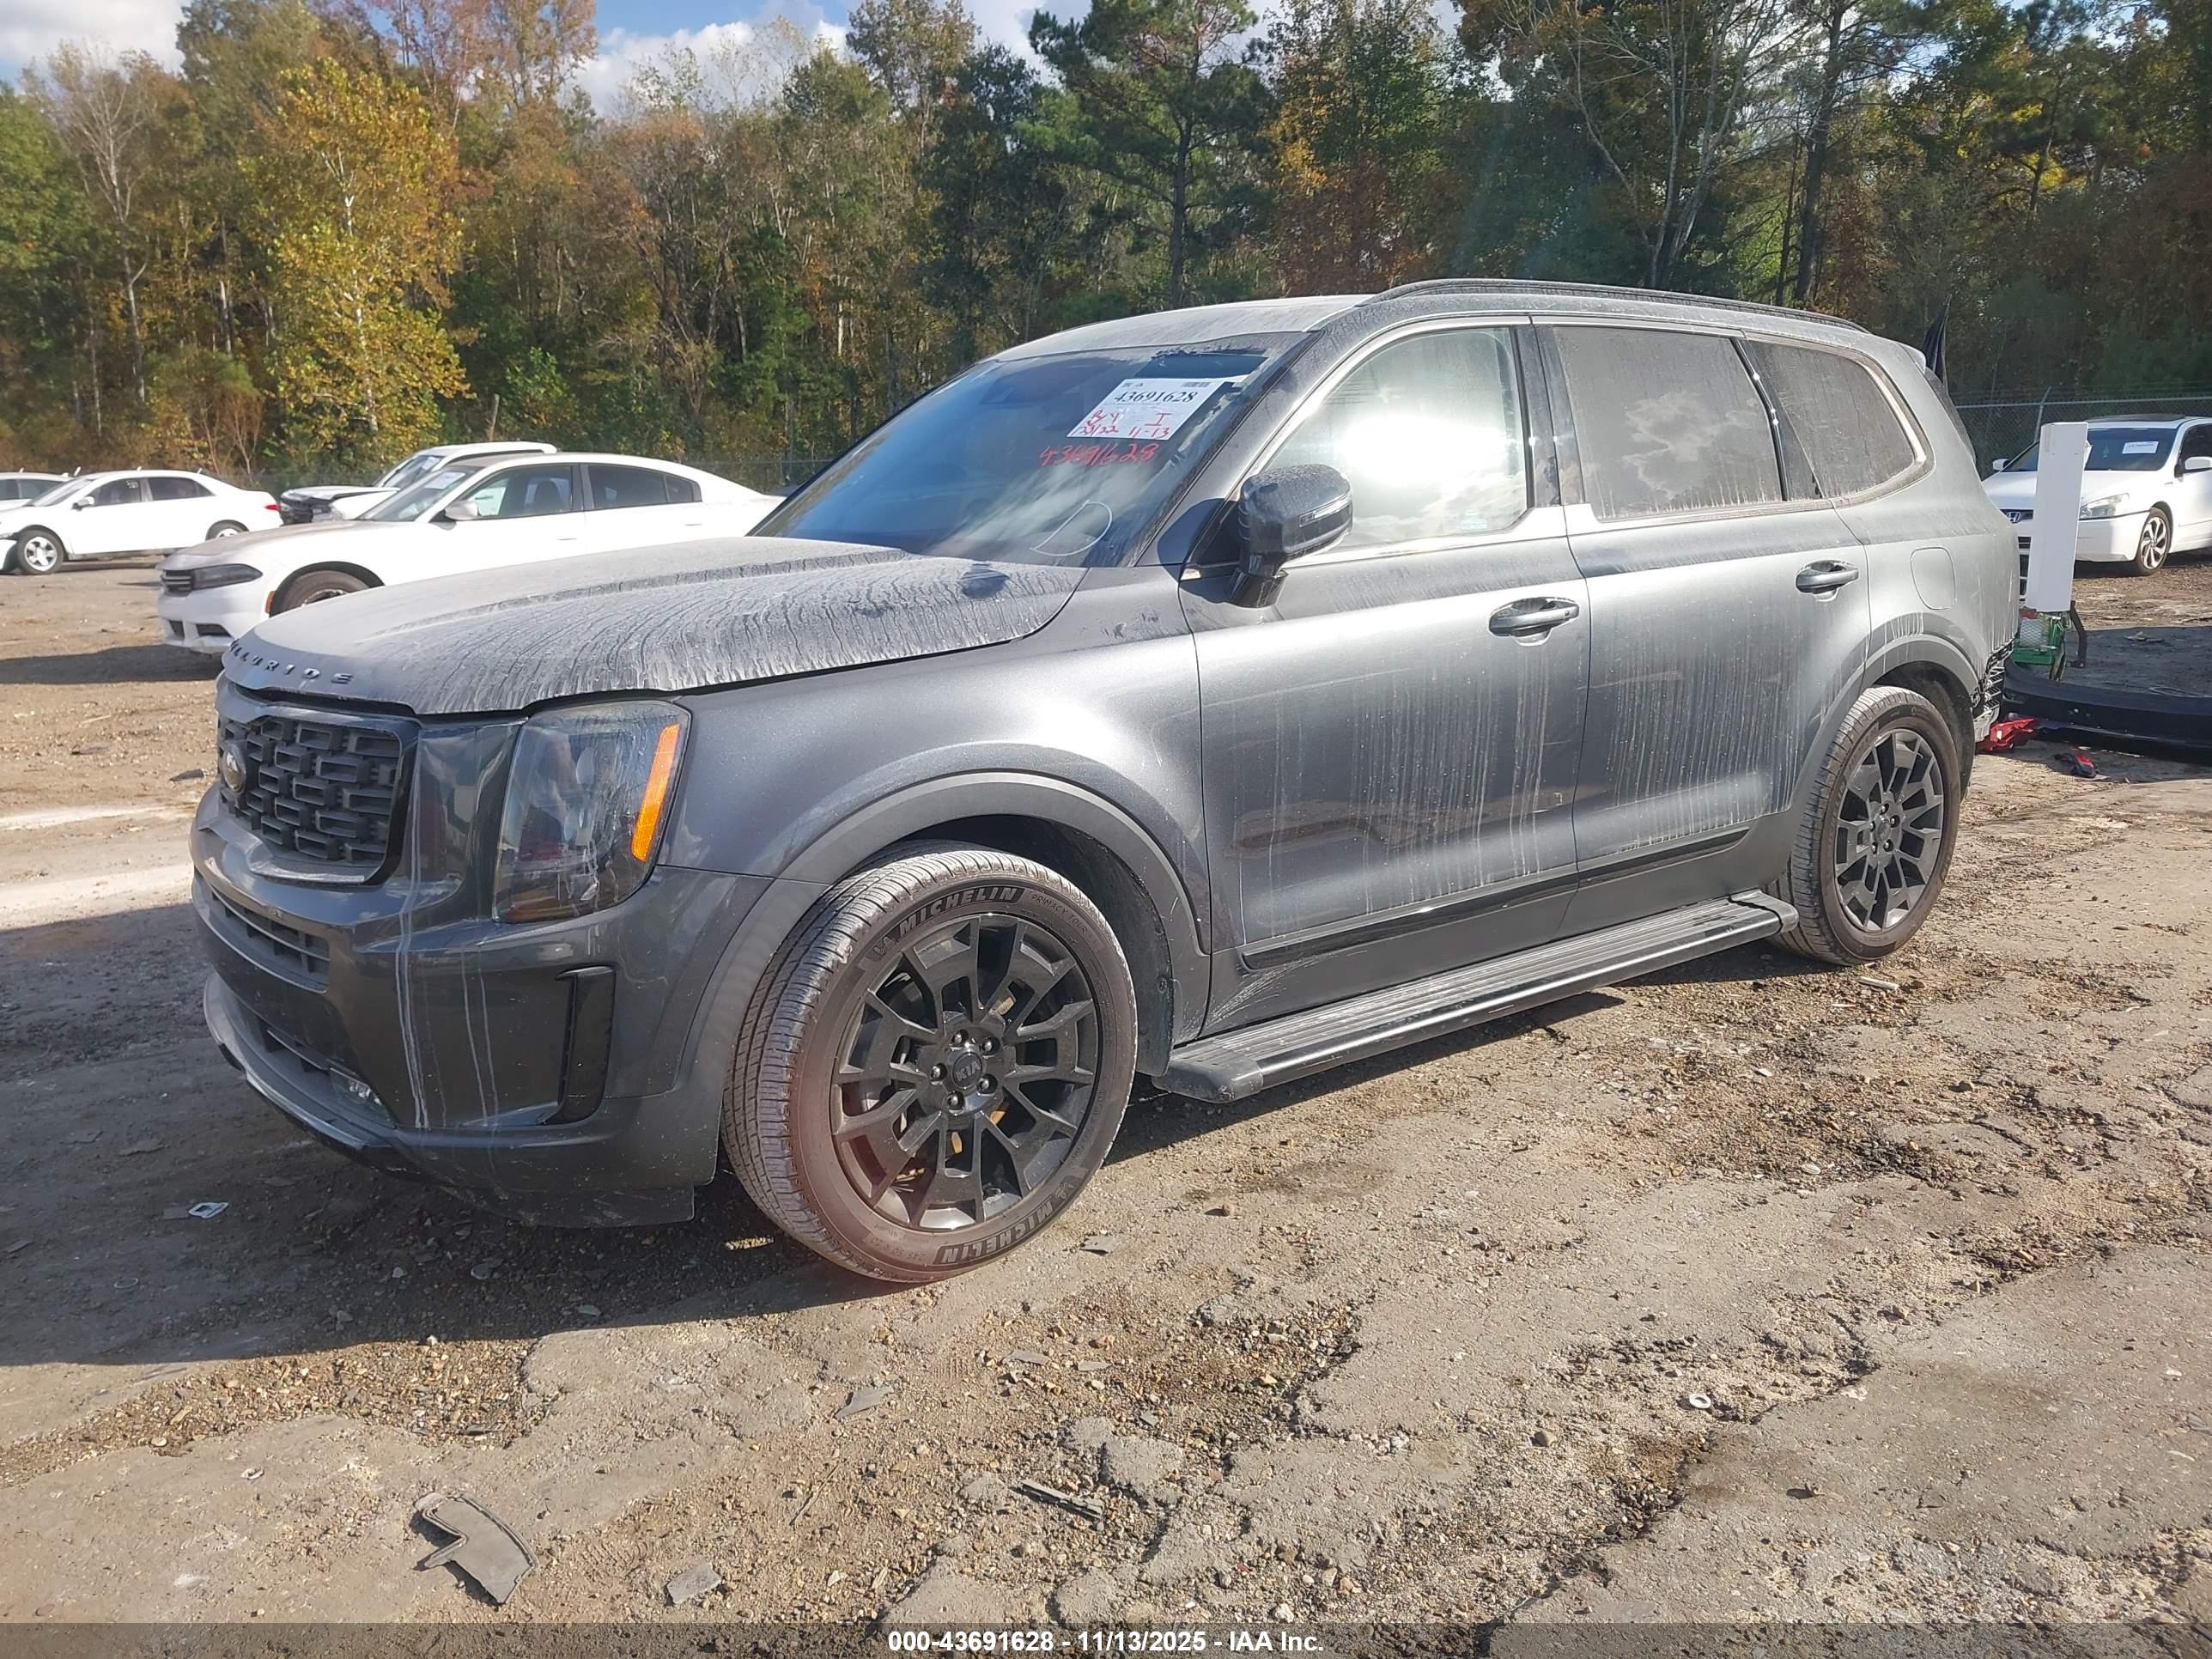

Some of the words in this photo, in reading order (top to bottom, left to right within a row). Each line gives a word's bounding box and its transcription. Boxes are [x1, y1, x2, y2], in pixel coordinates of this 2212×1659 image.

[1113, 391, 1199, 403] 43691628
[1038, 442, 1160, 467] 43691628
[899, 886, 1019, 936] MICHELIN
[1030, 893, 1069, 916] PRIMACY
[1069, 913, 1088, 934] TOUR
[955, 1060, 981, 1082] KIA
[940, 1200, 1054, 1264] MICHELIN
